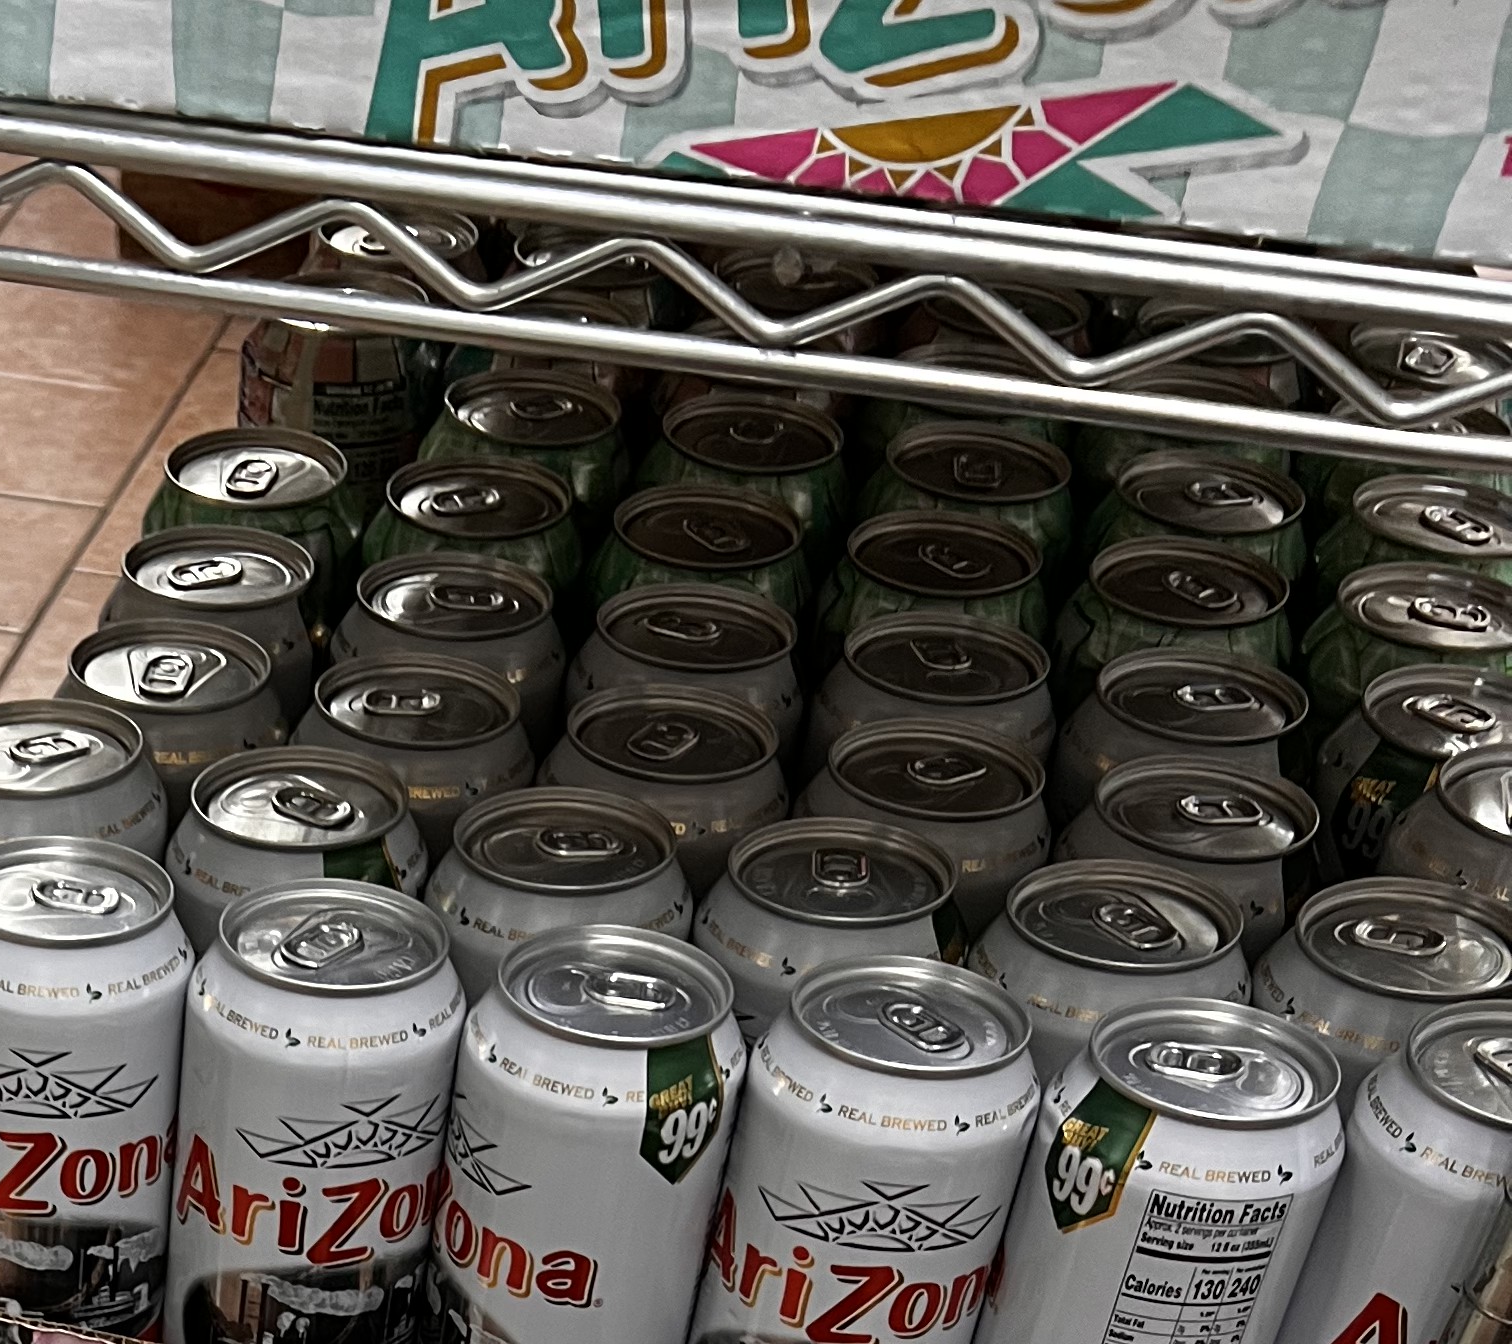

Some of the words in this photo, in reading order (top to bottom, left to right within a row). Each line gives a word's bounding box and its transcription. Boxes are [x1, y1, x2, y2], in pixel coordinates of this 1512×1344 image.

[306, 1034, 347, 1050] REAL
[349, 1029, 410, 1051] BREWED
[531, 1073, 596, 1101] BREWED
[837, 1103, 878, 1125] REAL
[880, 1115, 948, 1132] BREWED
[1158, 1160, 1201, 1181] REAL
[1204, 1169, 1272, 1184] BREWED
[1149, 1193, 1235, 1224] Nutrition
[1238, 1201, 1287, 1224] Facts
[1140, 1231, 1175, 1251] Serving
[1124, 1273, 1183, 1299] Calories
[1193, 1278, 1226, 1301] 130
[1227, 1273, 1262, 1299] 240
